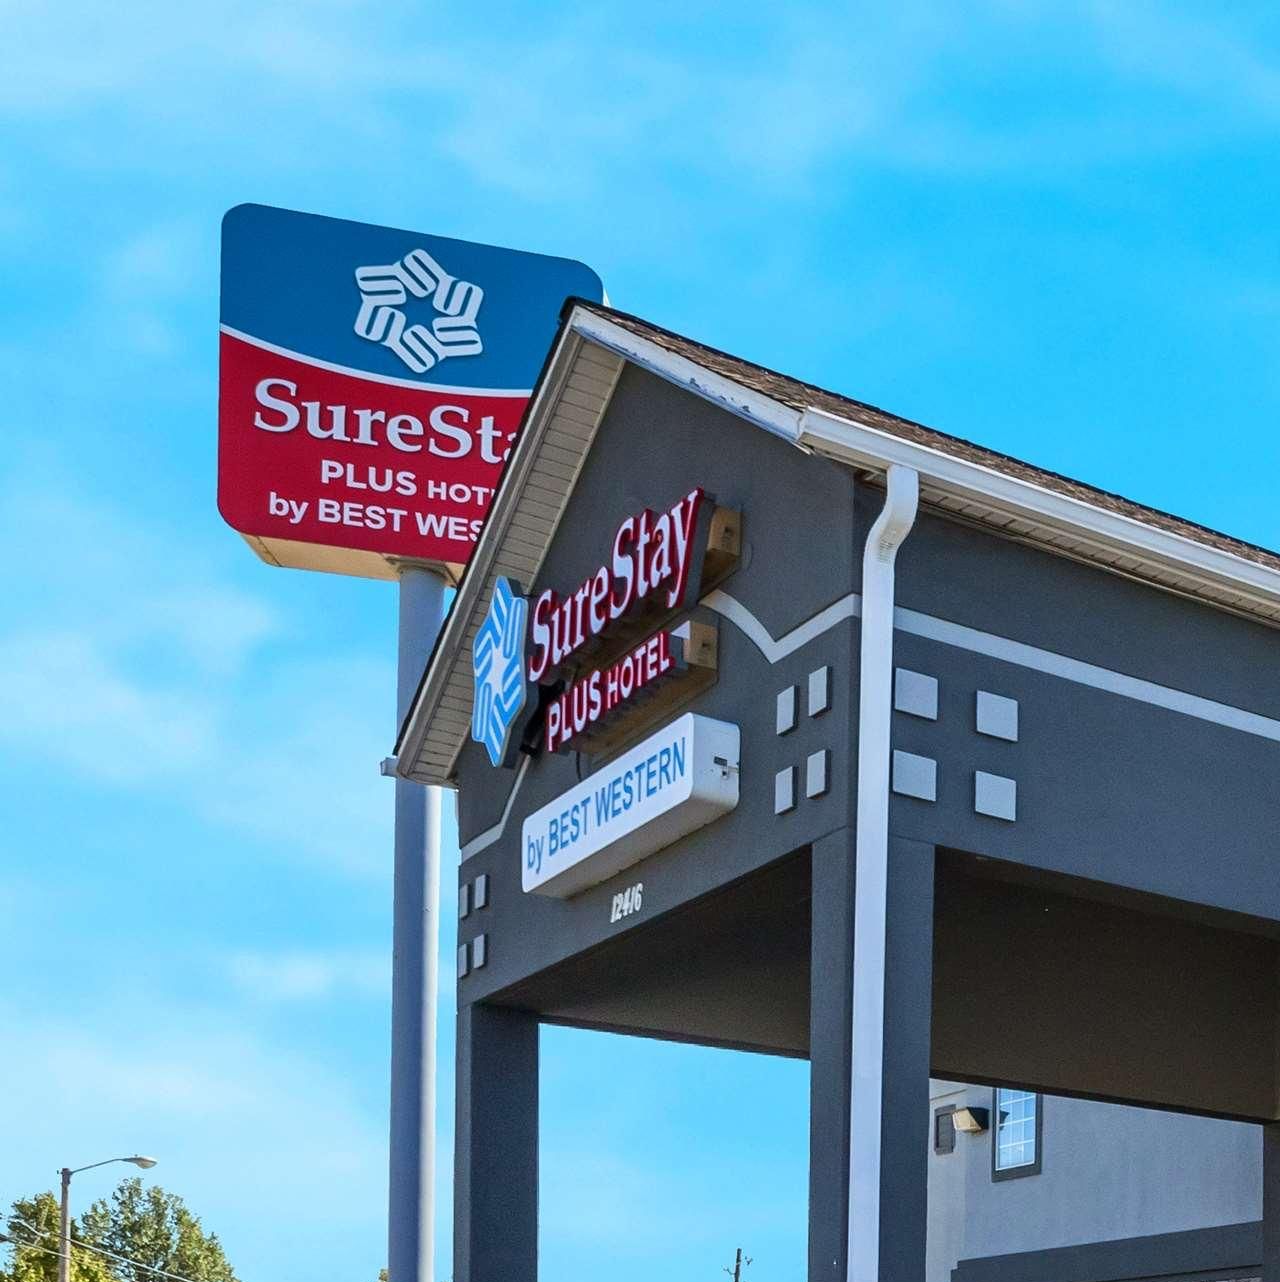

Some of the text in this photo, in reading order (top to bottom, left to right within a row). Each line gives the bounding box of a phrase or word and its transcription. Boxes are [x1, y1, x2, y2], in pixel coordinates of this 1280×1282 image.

[269, 491, 309, 524] by
[318, 498, 407, 532] BEST
[321, 459, 495, 506] PLUS HOT
[528, 489, 700, 682] SureStay
[547, 632, 671, 752] PLUS HOTEL
[527, 736, 686, 875] by BEST WESTERN
